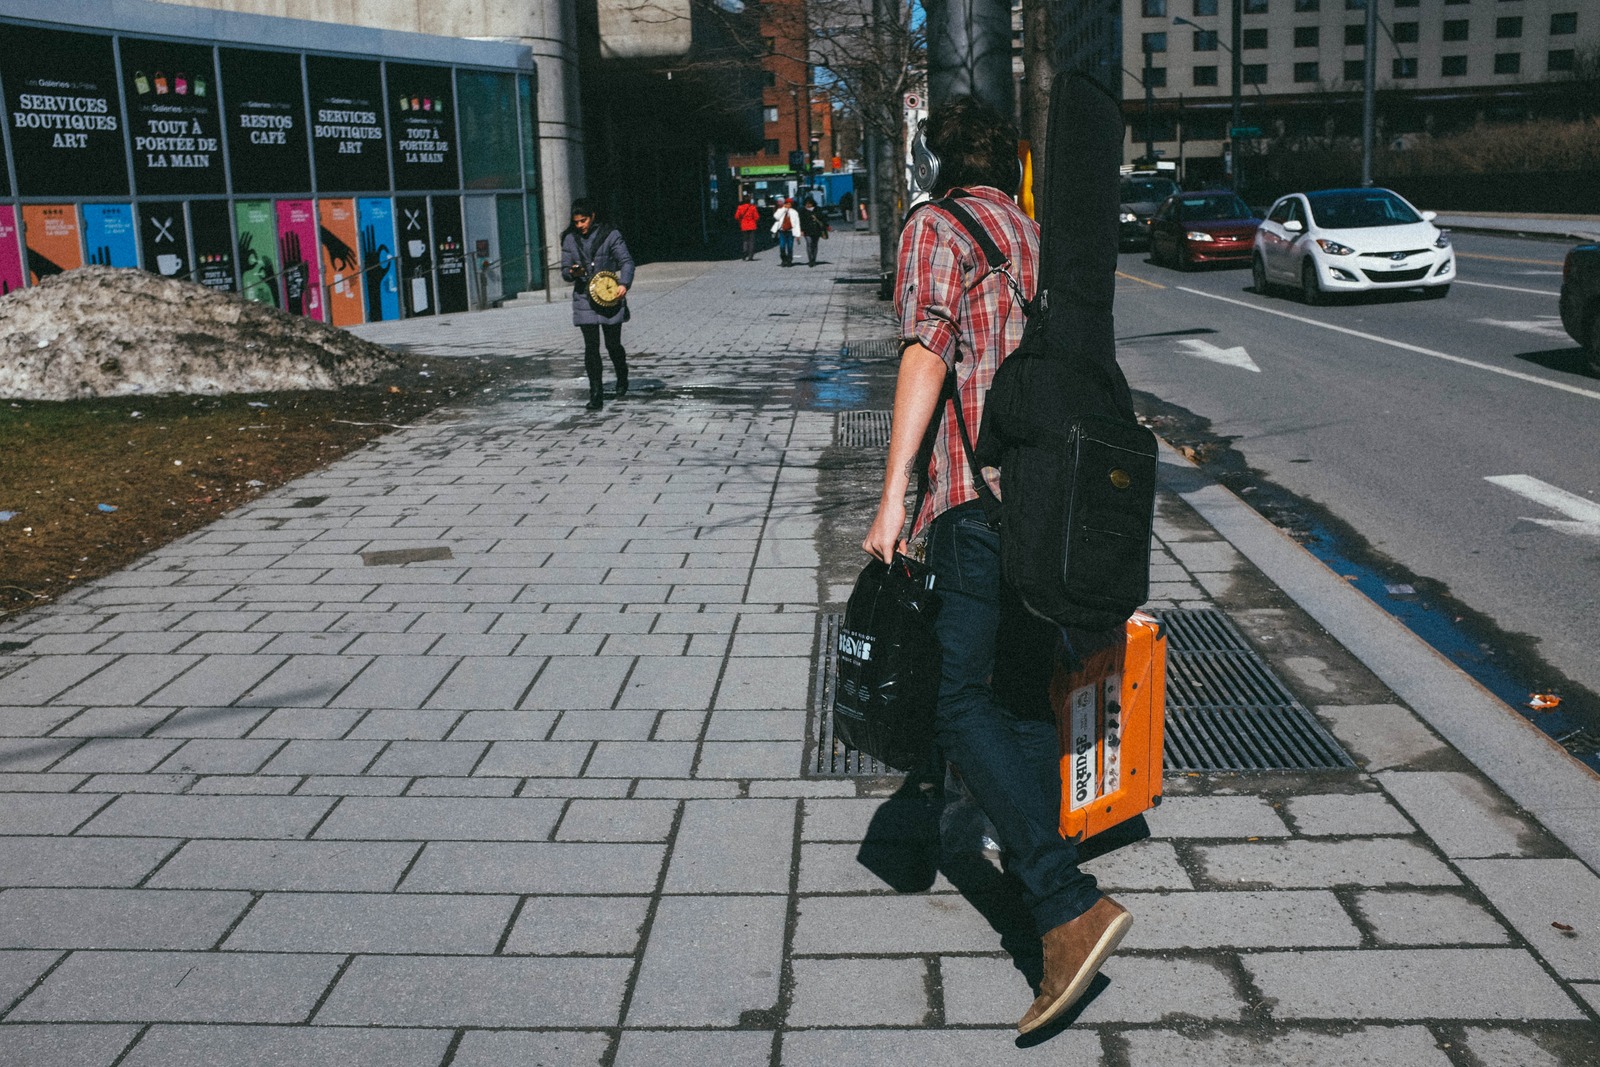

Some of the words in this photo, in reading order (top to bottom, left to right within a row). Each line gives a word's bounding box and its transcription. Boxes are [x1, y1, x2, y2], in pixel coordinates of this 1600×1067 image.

[19, 93, 108, 114] SERVICES
[13, 112, 118, 131] BOUTIQUES
[239, 113, 293, 129] RESTOS
[318, 109, 376, 125] SERVICES
[147, 120, 188, 135] TOUT
[192, 117, 202, 135] À
[314, 124, 382, 140] BOUTIQUES
[406, 128, 430, 140] TOUT
[52, 133, 88, 149] ART
[135, 132, 196, 151] PORTÉE
[198, 138, 218, 152] DE
[250, 128, 287, 145] CAFÉ
[338, 141, 363, 154] ART
[399, 139, 435, 152] PORTÉE
[436, 141, 448, 152] DE
[147, 154, 168, 168] LA
[170, 154, 210, 168] MAIN
[405, 152, 418, 163] LA
[419, 153, 444, 164] MAIN
[1076, 734, 1092, 802] ORANGE
